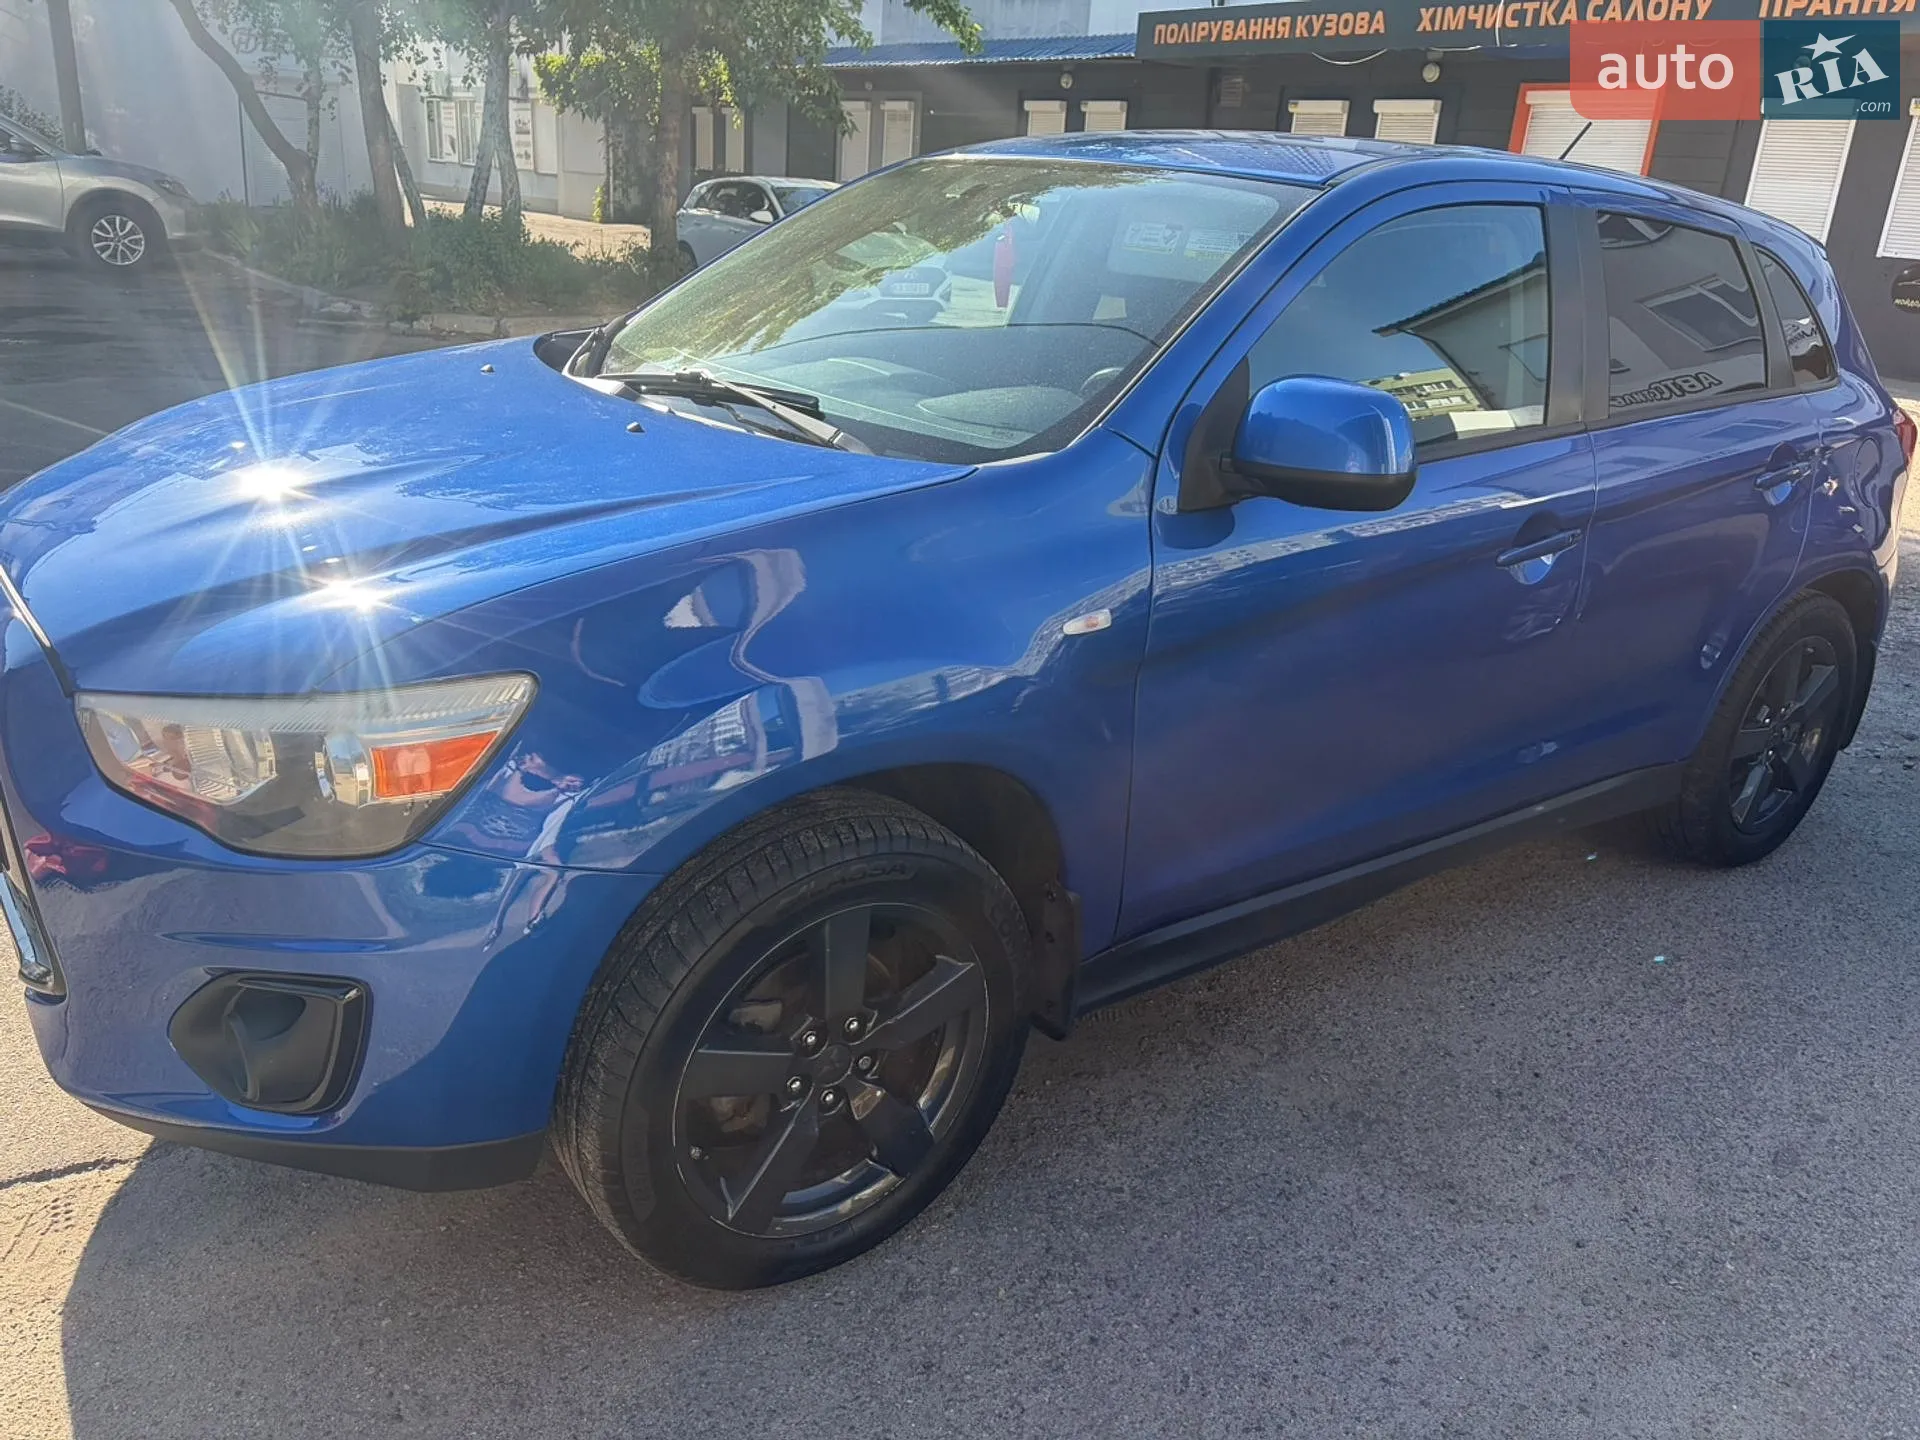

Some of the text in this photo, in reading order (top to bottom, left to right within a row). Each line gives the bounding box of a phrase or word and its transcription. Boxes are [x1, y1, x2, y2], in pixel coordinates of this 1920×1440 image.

[1154, 10, 1384, 44] ПОЛІРУВАННЯ КУЗОВА
[1416, 0, 1712, 32] ХІМЧИСТКА САЛОНУ
